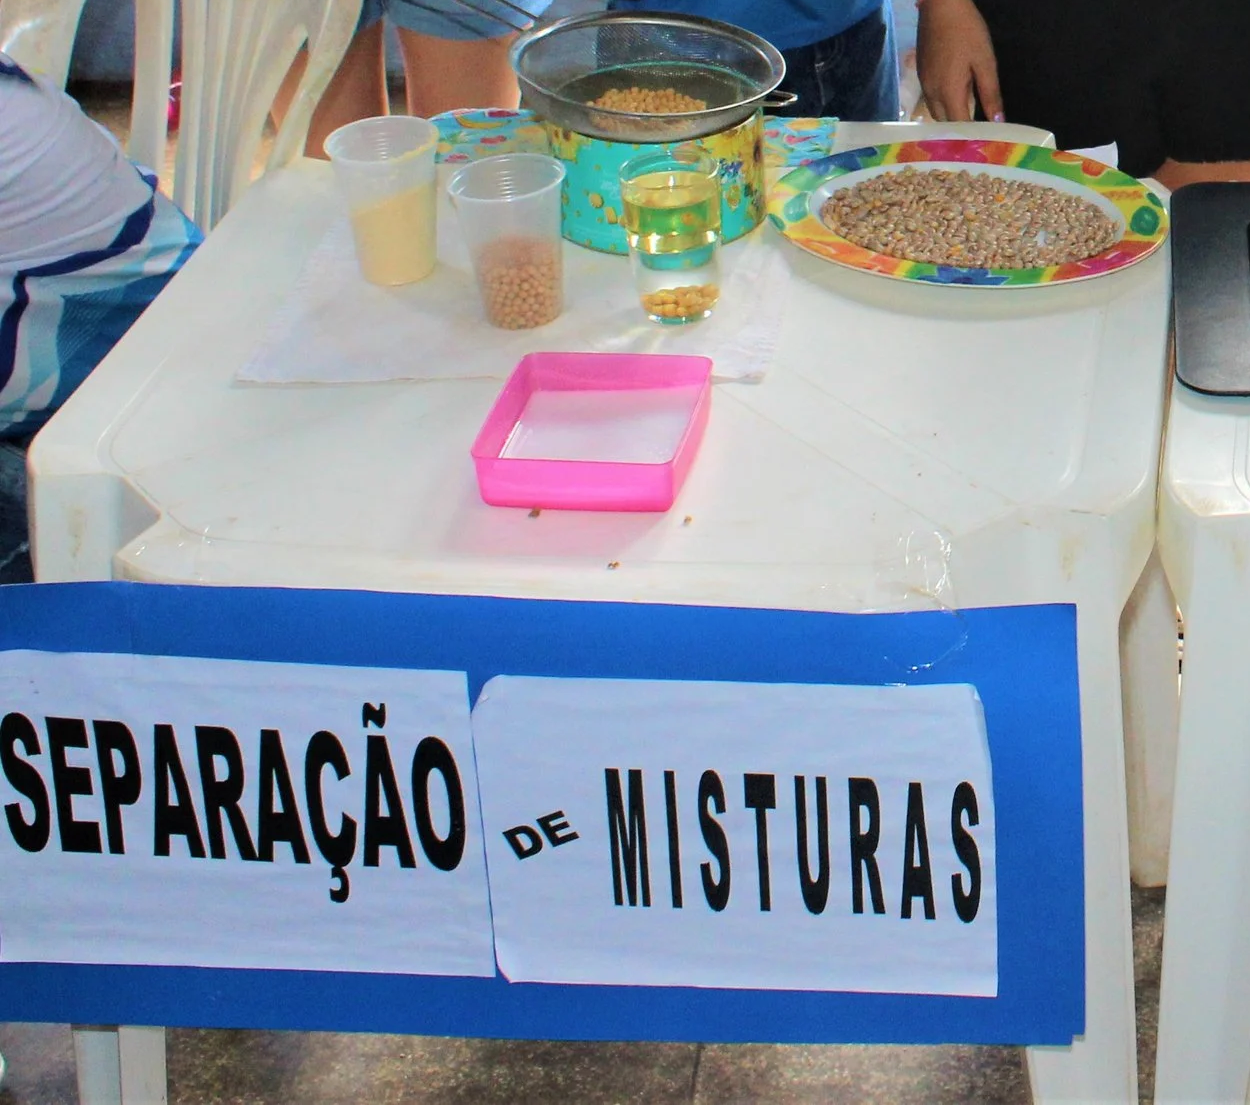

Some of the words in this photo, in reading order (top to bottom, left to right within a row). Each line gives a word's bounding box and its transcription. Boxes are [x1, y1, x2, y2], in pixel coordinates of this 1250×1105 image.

[0, 702, 466, 903] SEPARAÇÃO
[502, 810, 579, 860] DE
[605, 767, 982, 923] MISTURAS
